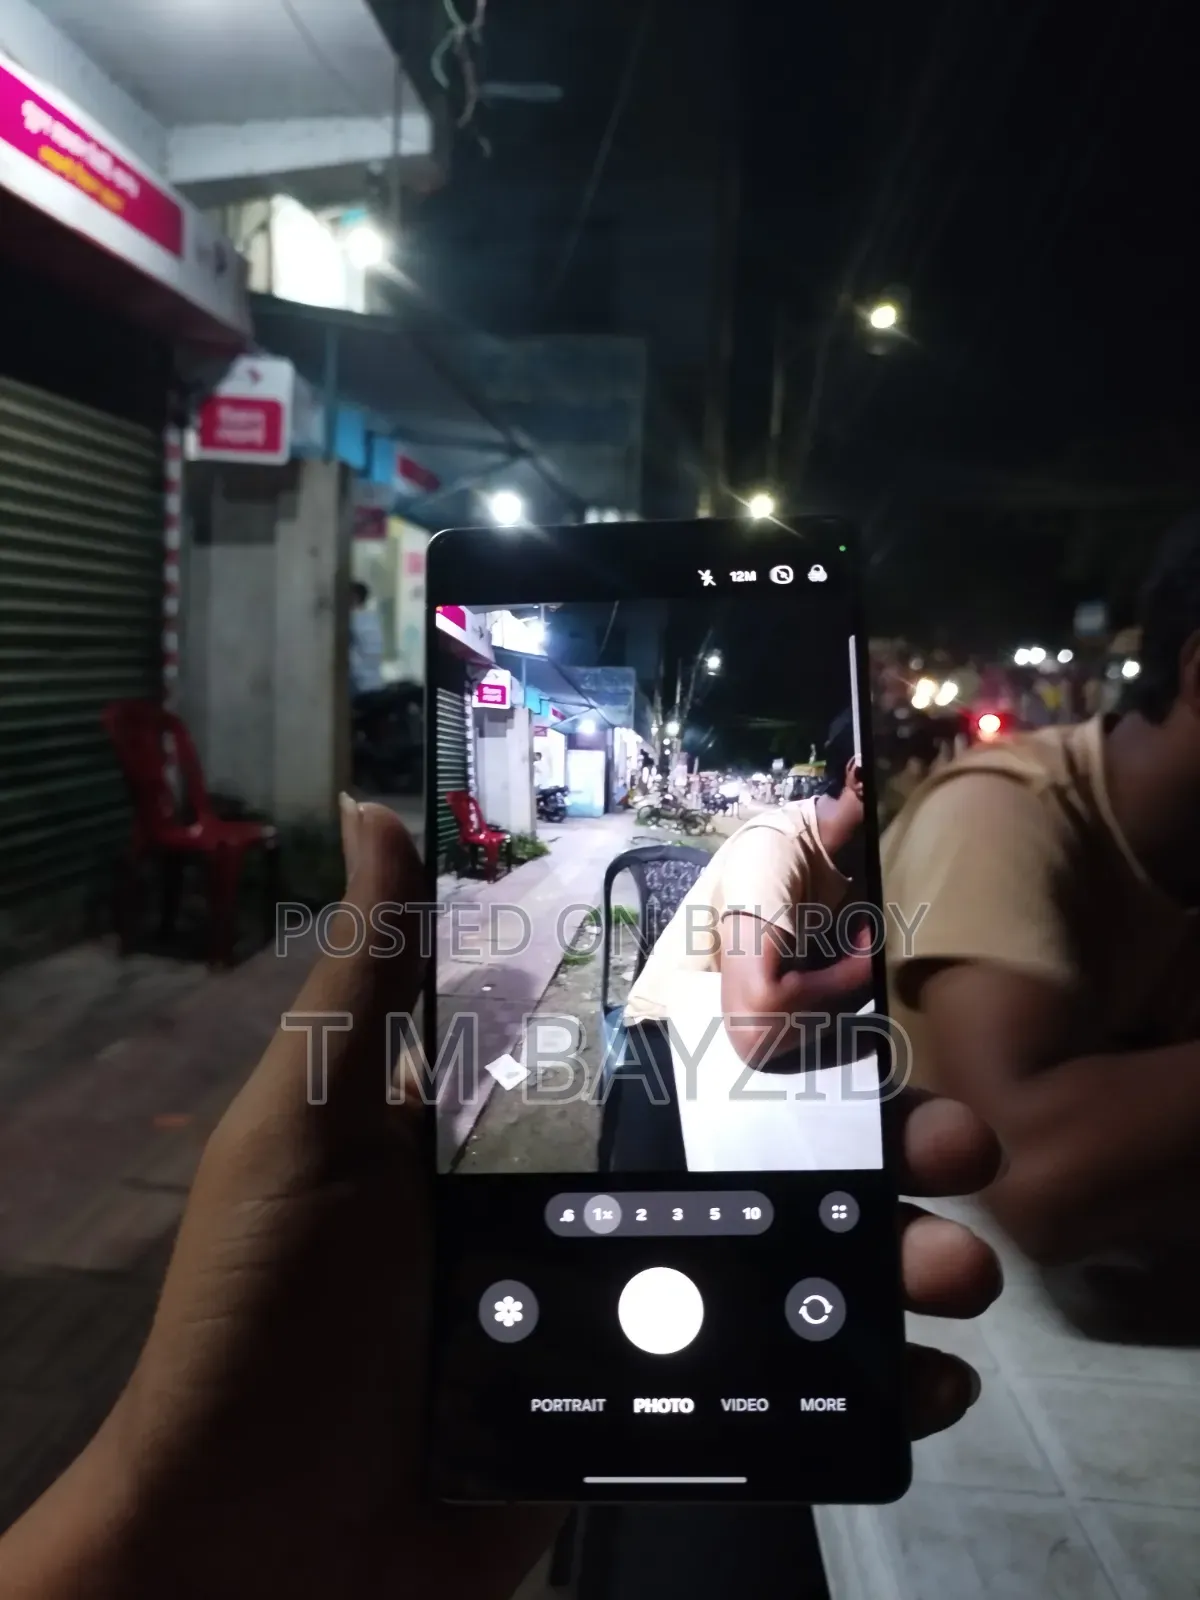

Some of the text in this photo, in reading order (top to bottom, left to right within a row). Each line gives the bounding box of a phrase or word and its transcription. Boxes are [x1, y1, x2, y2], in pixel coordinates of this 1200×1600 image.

[729, 570, 757, 583] 12M
[635, 1208, 648, 1222] 2
[671, 1207, 684, 1221] 3
[709, 1207, 721, 1221] 5
[742, 1206, 762, 1221] 10
[530, 1397, 847, 1414] PORTRAIT PHOTO VIDEO MORE
